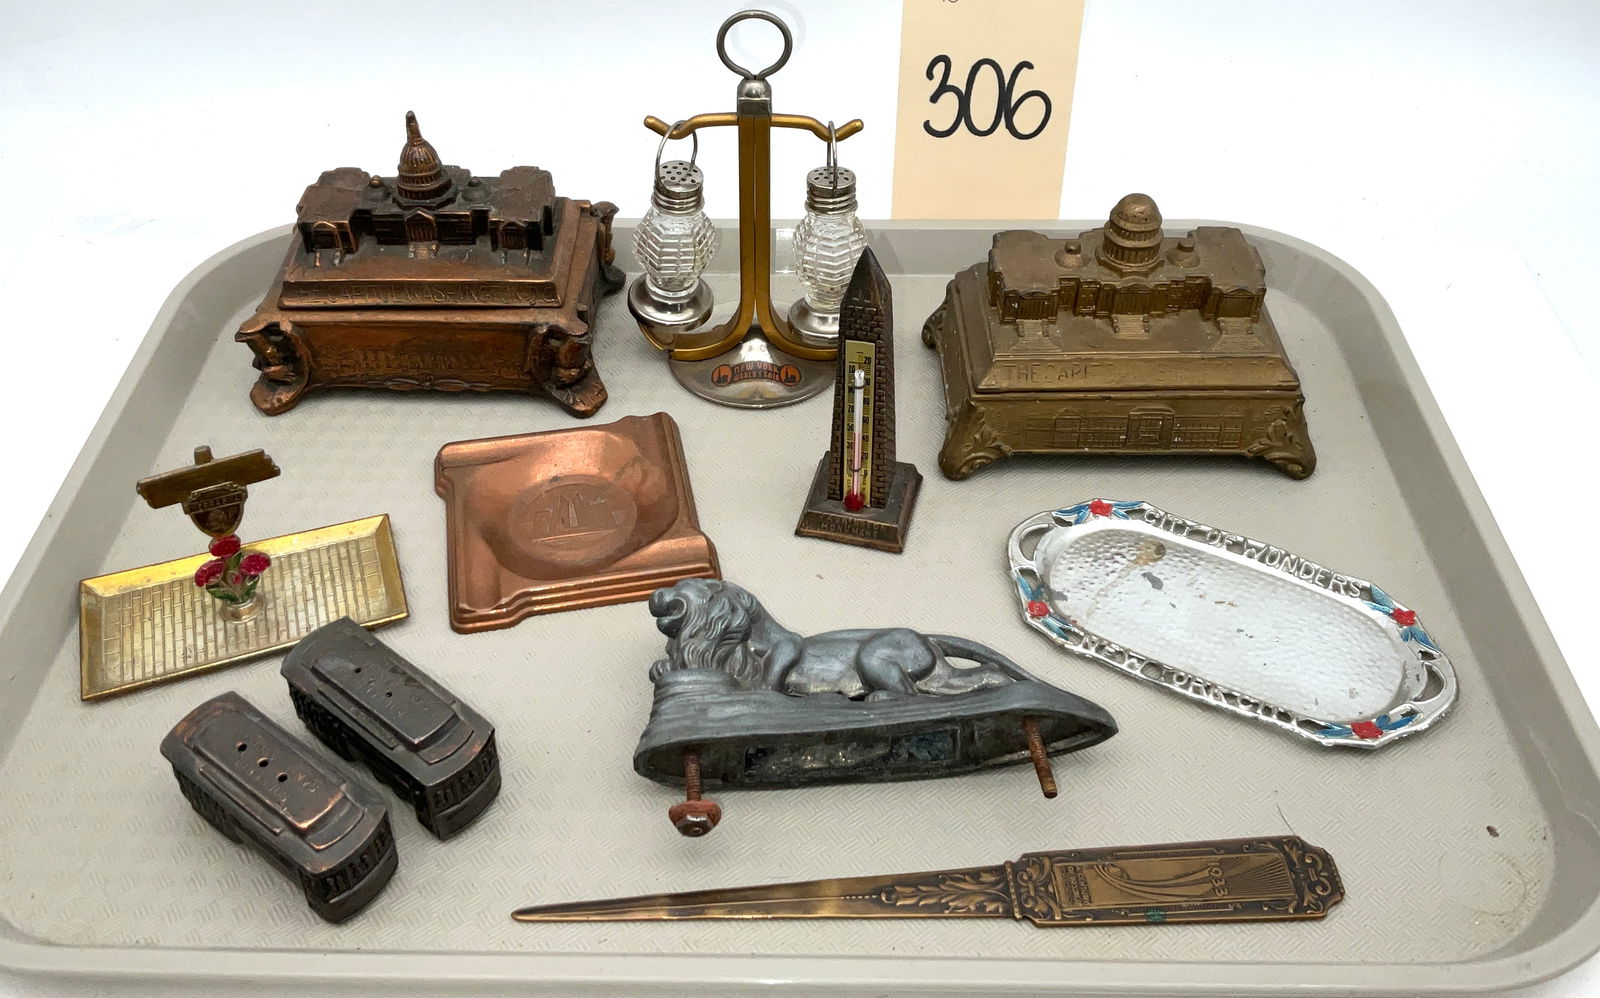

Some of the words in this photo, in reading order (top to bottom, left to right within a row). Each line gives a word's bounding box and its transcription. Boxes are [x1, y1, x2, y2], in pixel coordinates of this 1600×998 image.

[923, 54, 1052, 140] 306
[1001, 362, 1042, 384] THE
[821, 522, 878, 539] MONUMENT
[1144, 508, 1194, 538] CITY
[1206, 529, 1238, 550] OF
[1243, 537, 1362, 599] WONDERS
[1080, 634, 1148, 674] NEW
[1207, 862, 1229, 898] 1933
